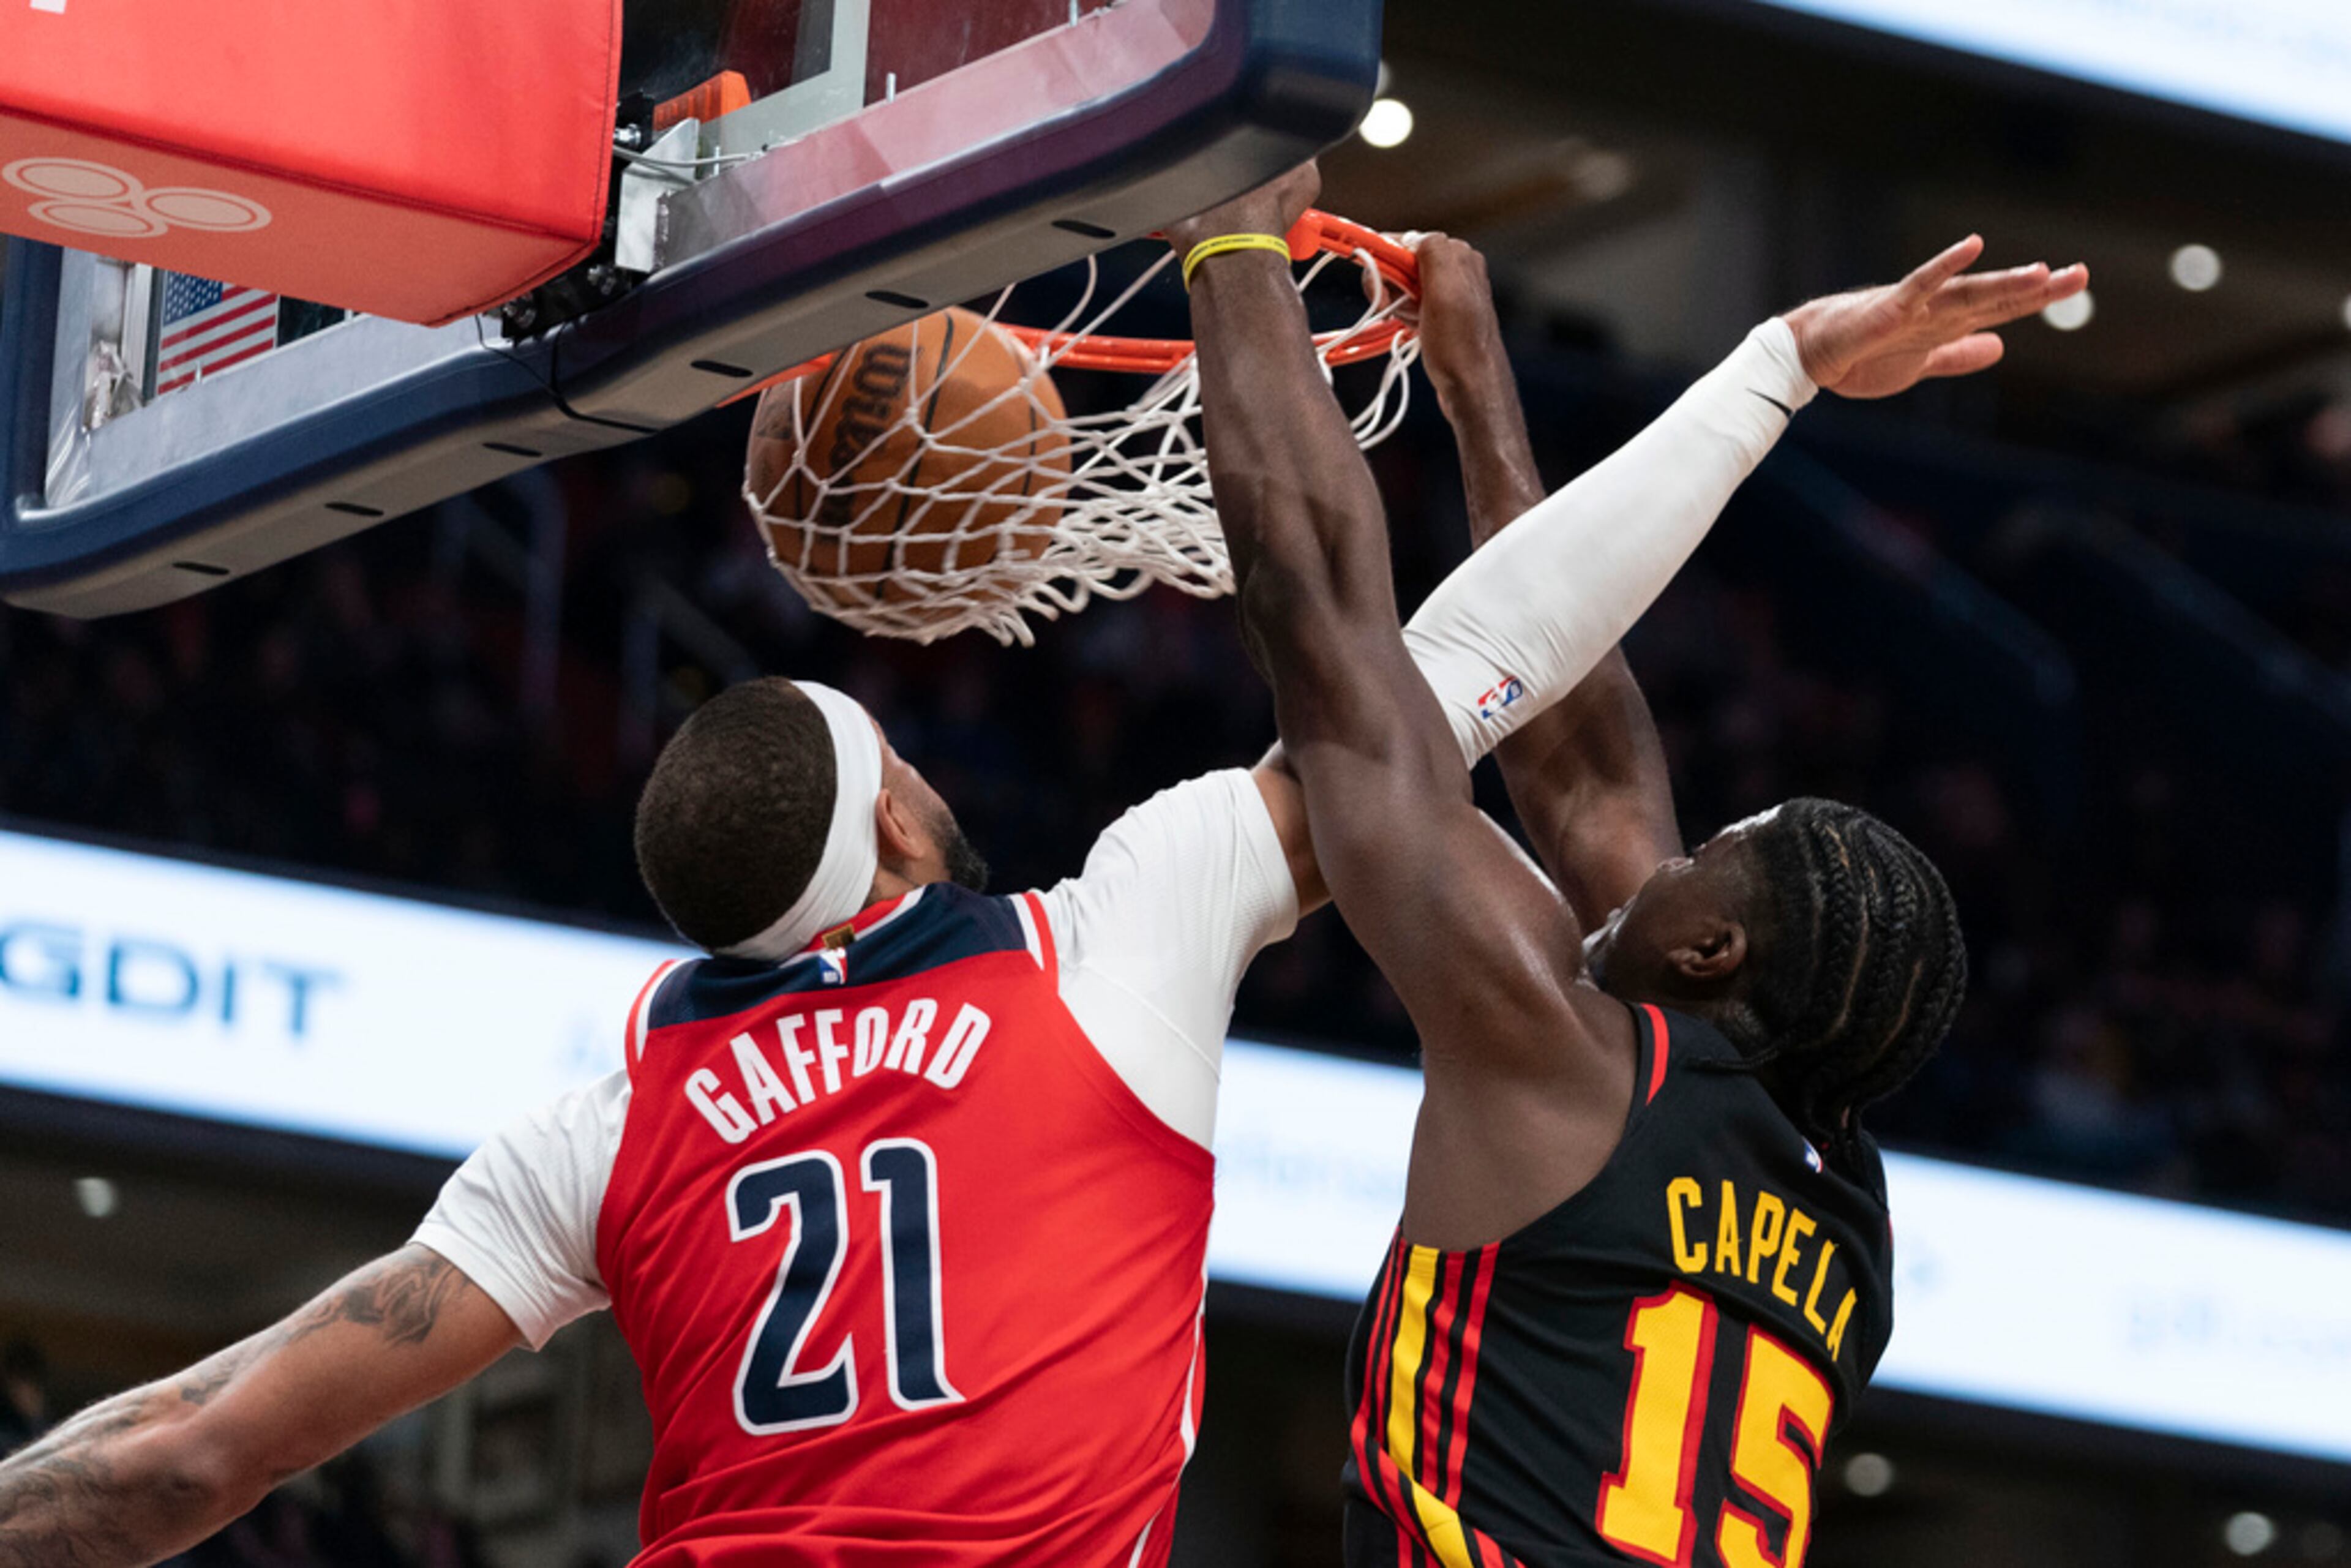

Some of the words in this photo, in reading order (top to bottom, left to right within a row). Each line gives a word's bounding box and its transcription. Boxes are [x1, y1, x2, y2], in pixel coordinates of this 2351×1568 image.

[0, 920, 347, 1039] GDIT
[684, 998, 991, 1144] GAFFORD
[726, 1137, 966, 1435] 21
[1666, 1177, 1858, 1362] CAPELA
[1595, 1279, 1835, 1568] 15
